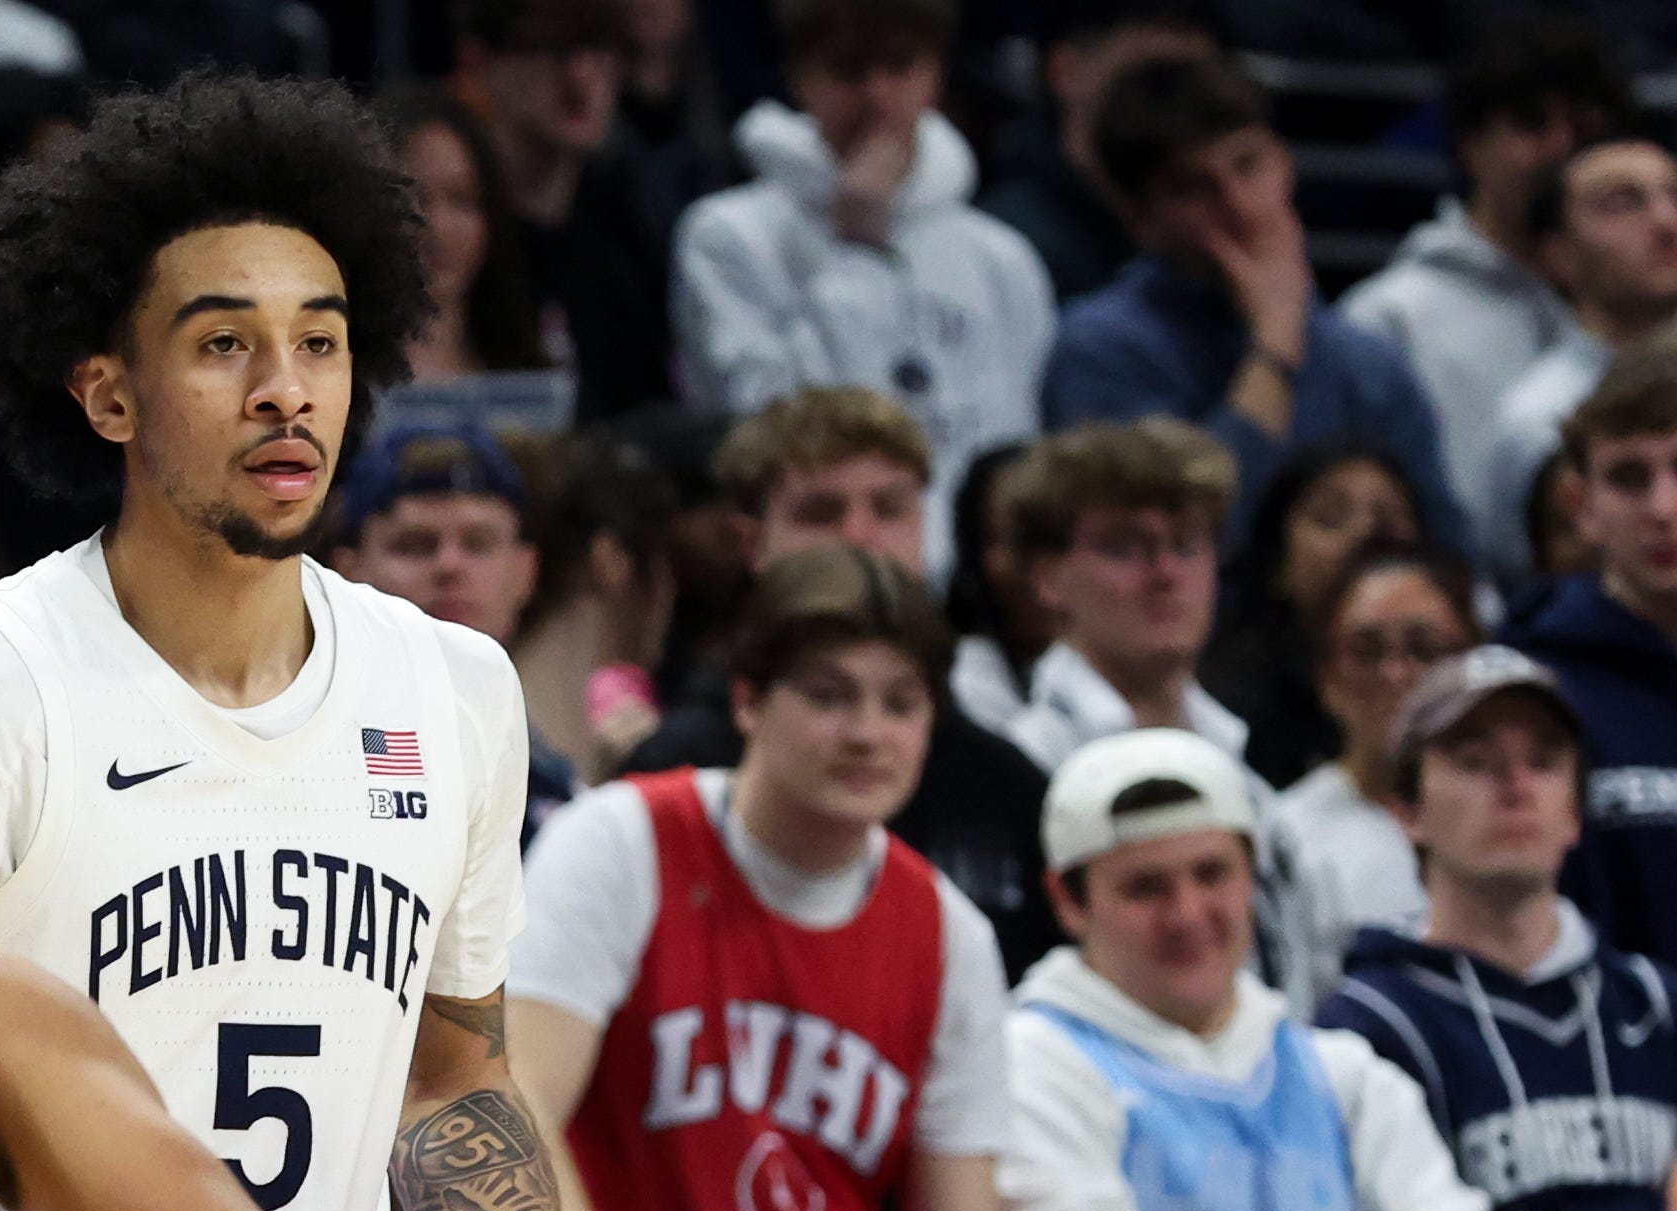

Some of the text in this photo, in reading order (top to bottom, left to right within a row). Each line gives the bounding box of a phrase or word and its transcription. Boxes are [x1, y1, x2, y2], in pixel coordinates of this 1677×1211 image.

[89, 849, 430, 1017] PENN STATE
[424, 1115, 507, 1169] 95
